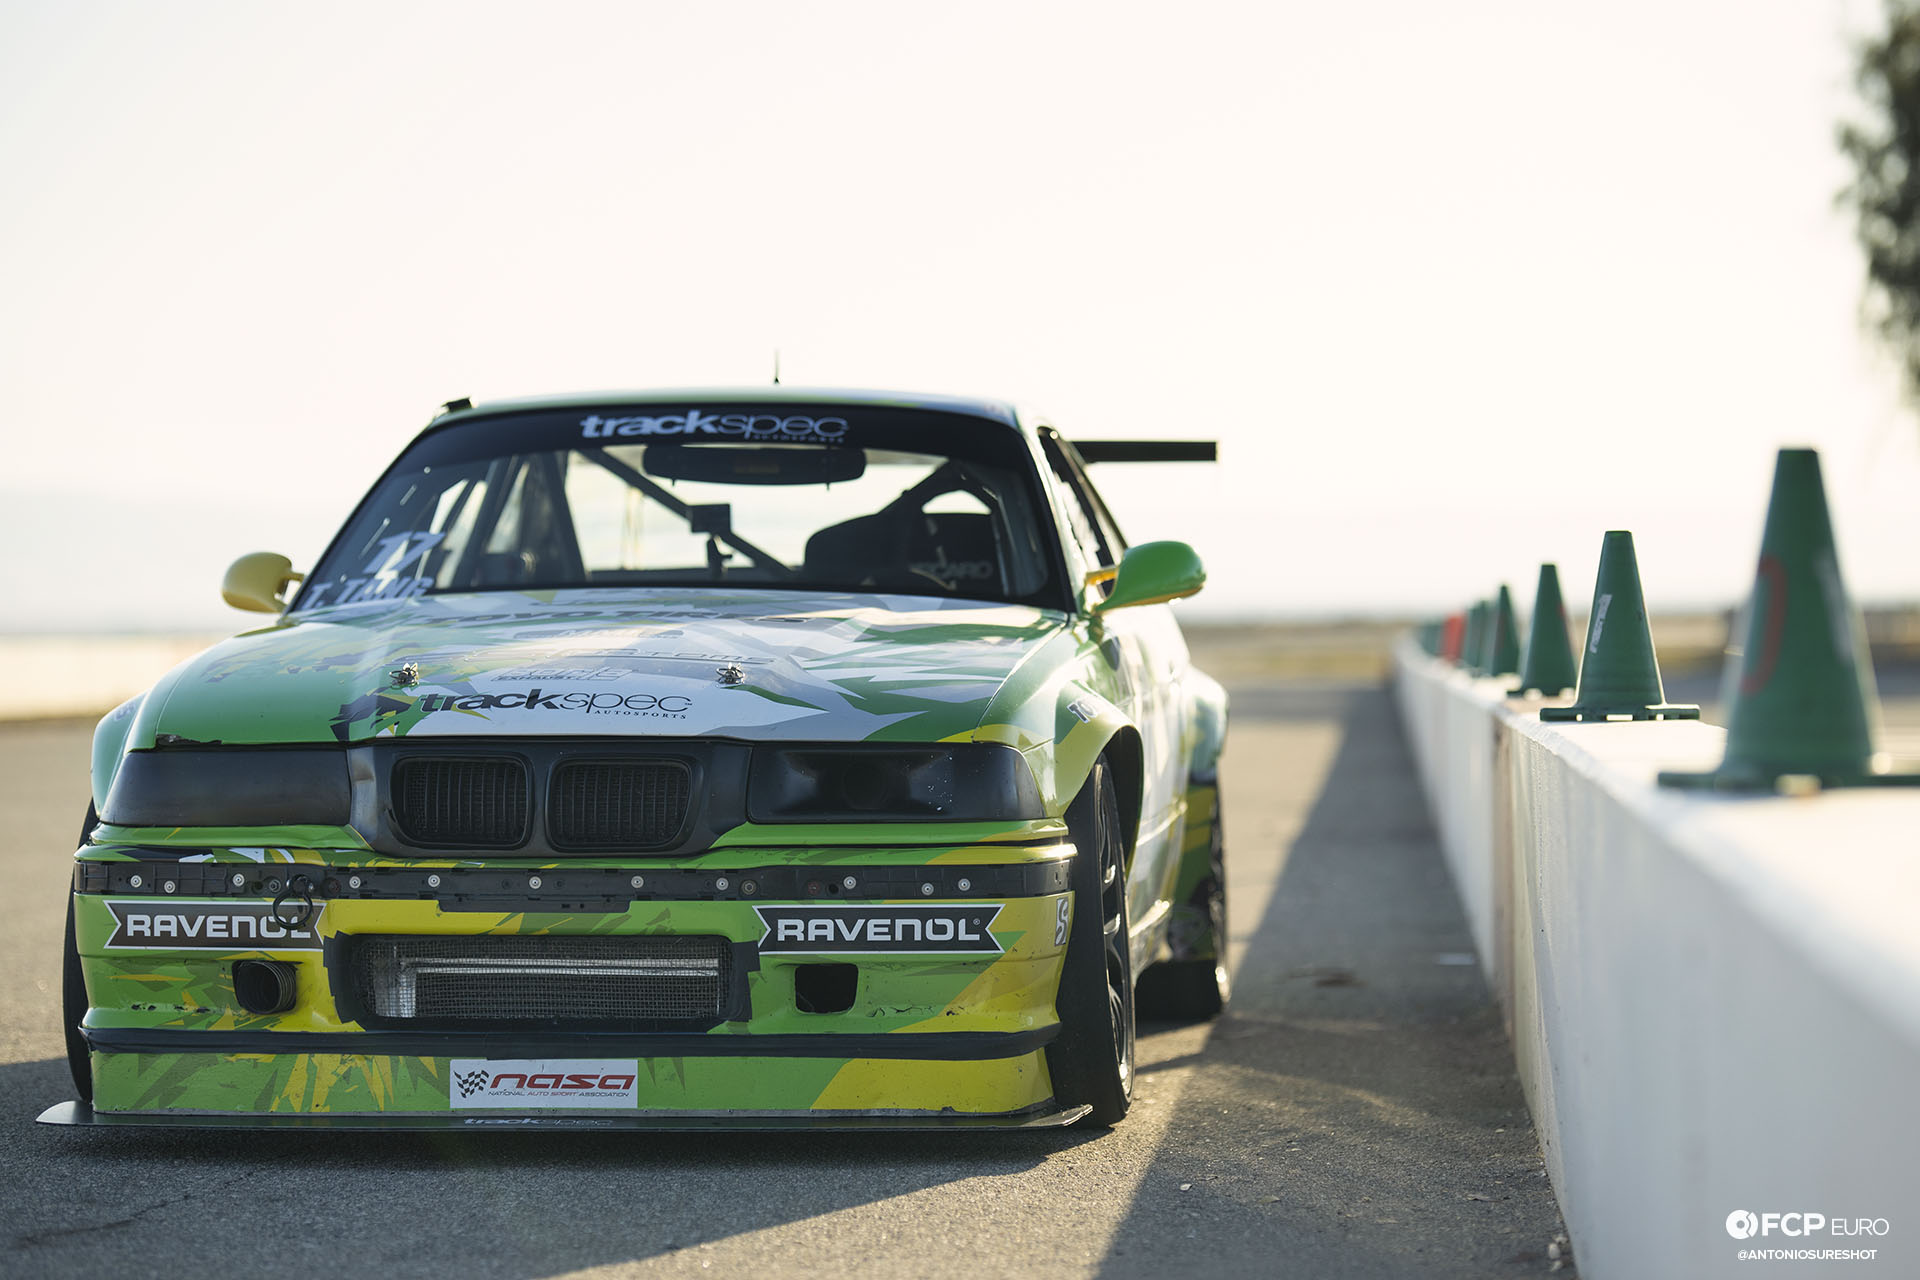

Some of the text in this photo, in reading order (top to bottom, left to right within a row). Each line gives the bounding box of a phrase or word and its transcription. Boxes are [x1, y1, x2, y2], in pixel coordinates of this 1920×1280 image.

[580, 410, 849, 439] trackspec
[362, 531, 446, 574] 17
[420, 689, 689, 714] trackspec
[593, 709, 687, 720] AUTOSPORTS
[490, 1073, 636, 1090] nasa
